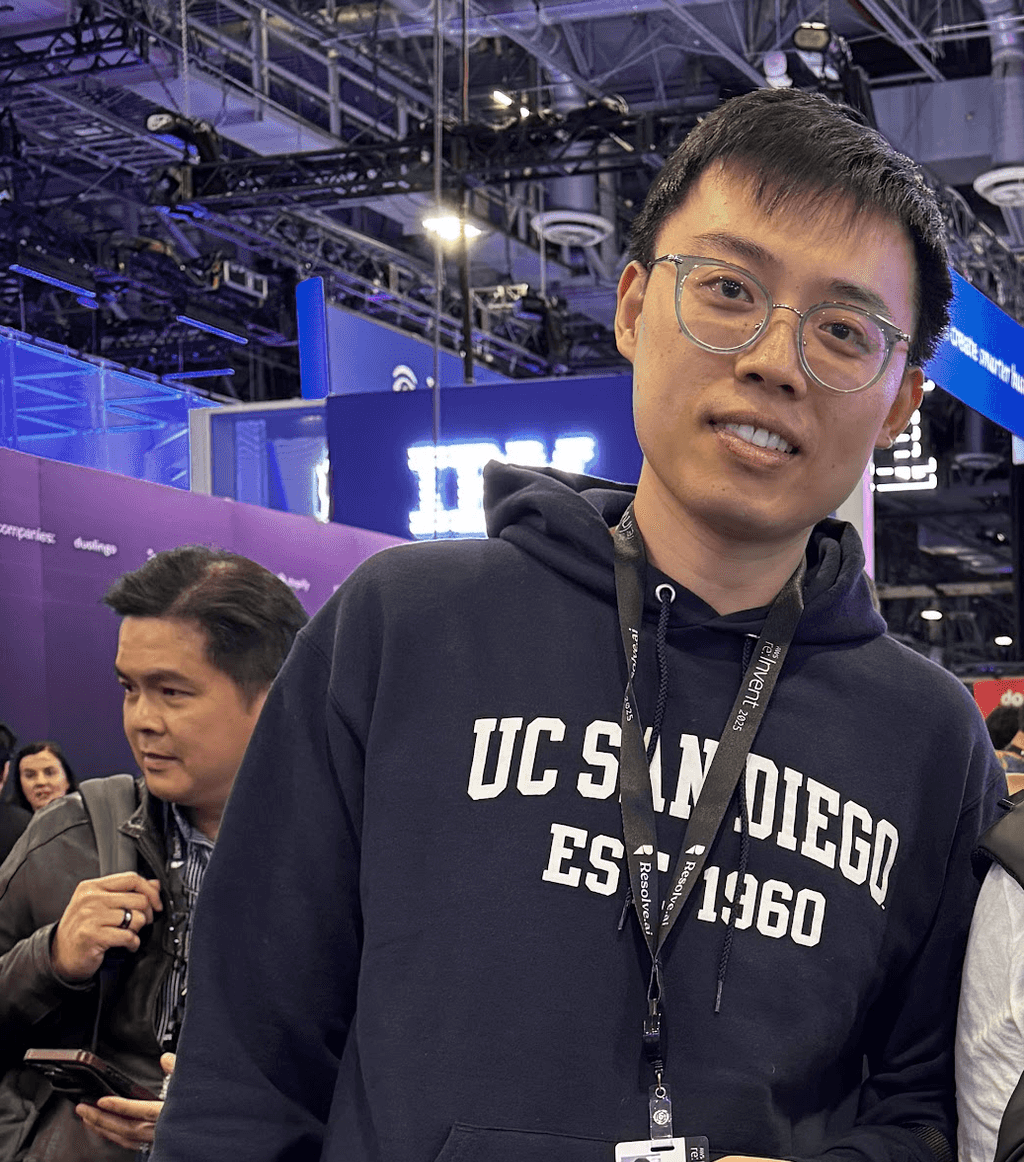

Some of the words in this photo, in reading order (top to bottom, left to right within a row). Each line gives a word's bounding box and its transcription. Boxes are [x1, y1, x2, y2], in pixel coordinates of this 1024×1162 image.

[742, 640, 777, 709] re:Invent
[732, 708, 749, 732] 2025
[467, 716, 566, 801] UC
[638, 861, 654, 936] Resolve.ai
[697, 865, 827, 948] 1960
